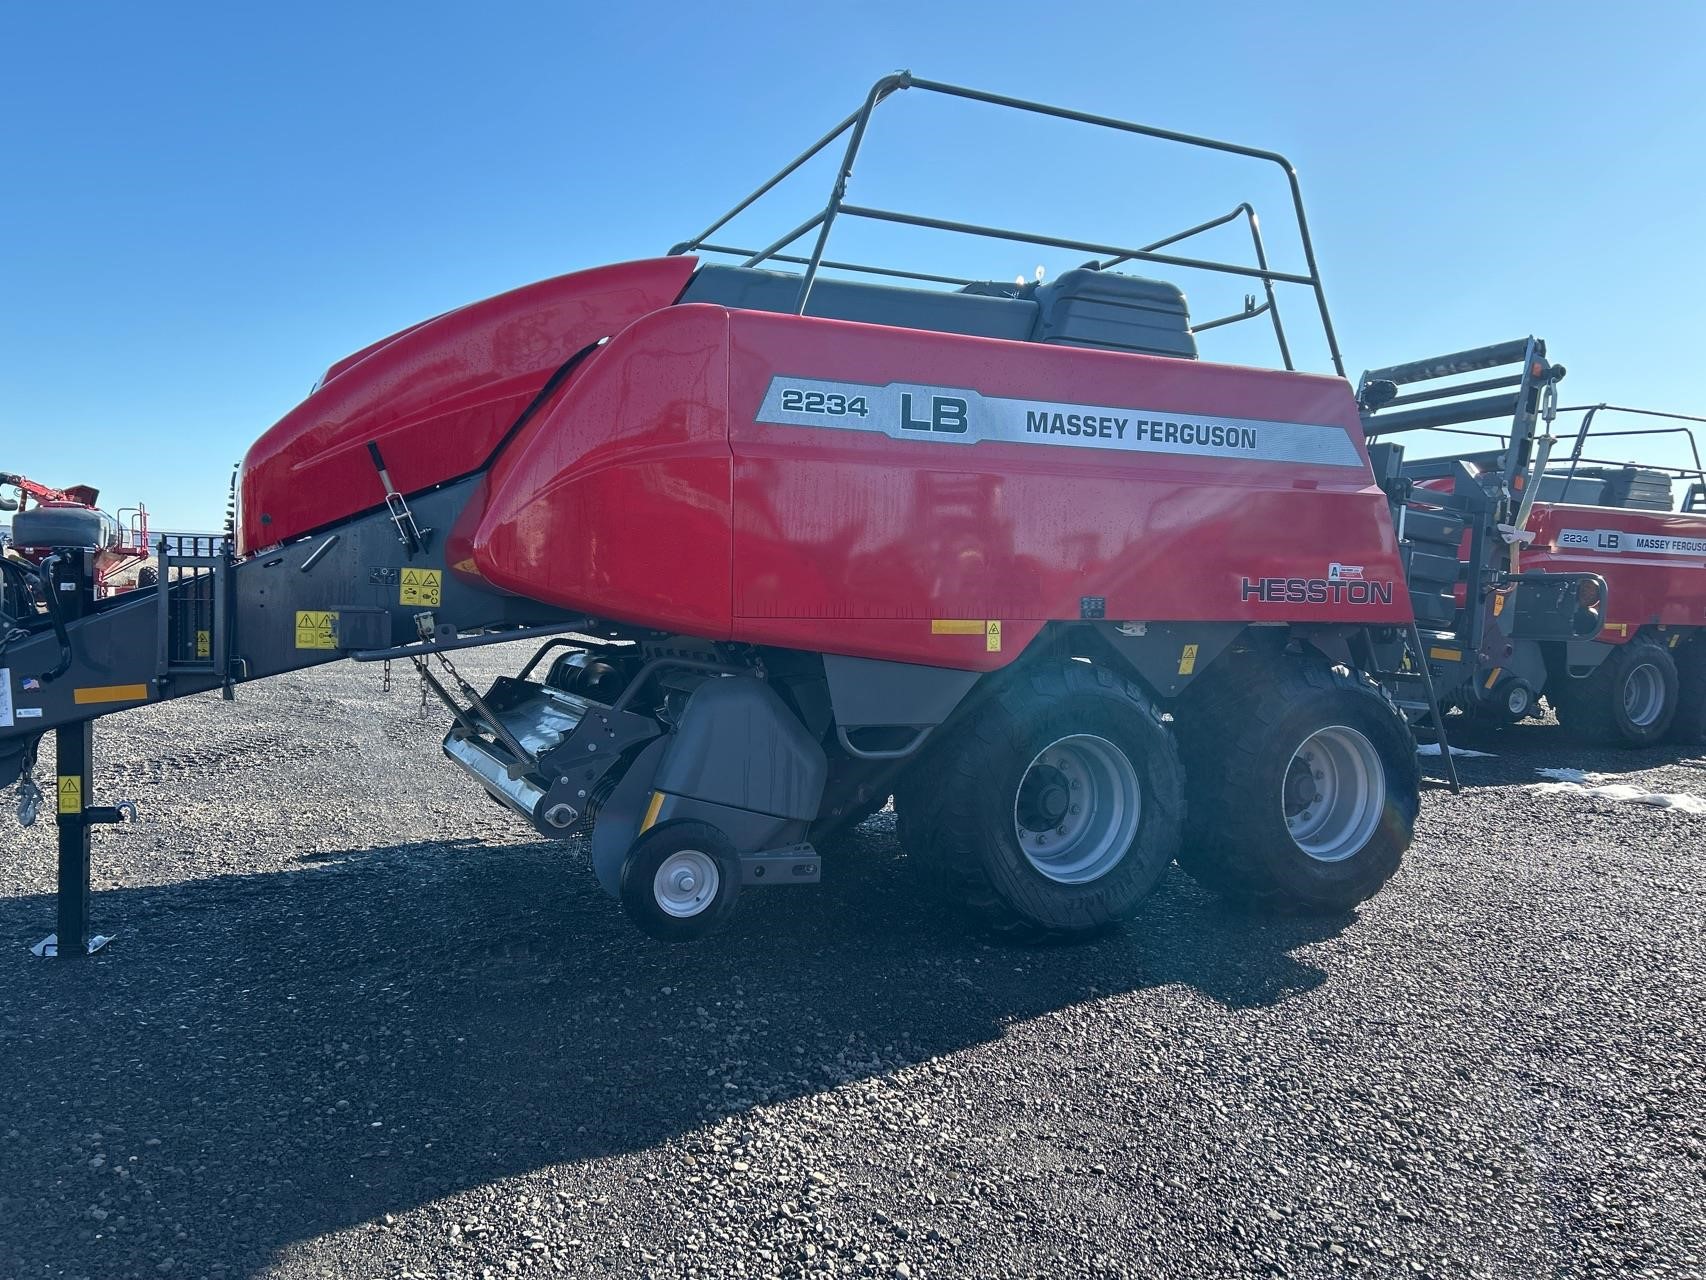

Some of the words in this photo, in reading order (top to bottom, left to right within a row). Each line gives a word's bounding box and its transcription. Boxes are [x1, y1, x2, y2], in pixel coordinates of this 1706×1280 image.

[781, 389, 869, 417] 2234
[900, 393, 968, 434] LB
[1026, 411, 1129, 439] MASSEY
[1137, 420, 1257, 449] FERGUSON
[1563, 534, 1588, 543] 2234
[1598, 534, 1619, 548] LB
[1636, 538, 1670, 550] MASSEY
[1241, 577, 1393, 605] HESSTON
